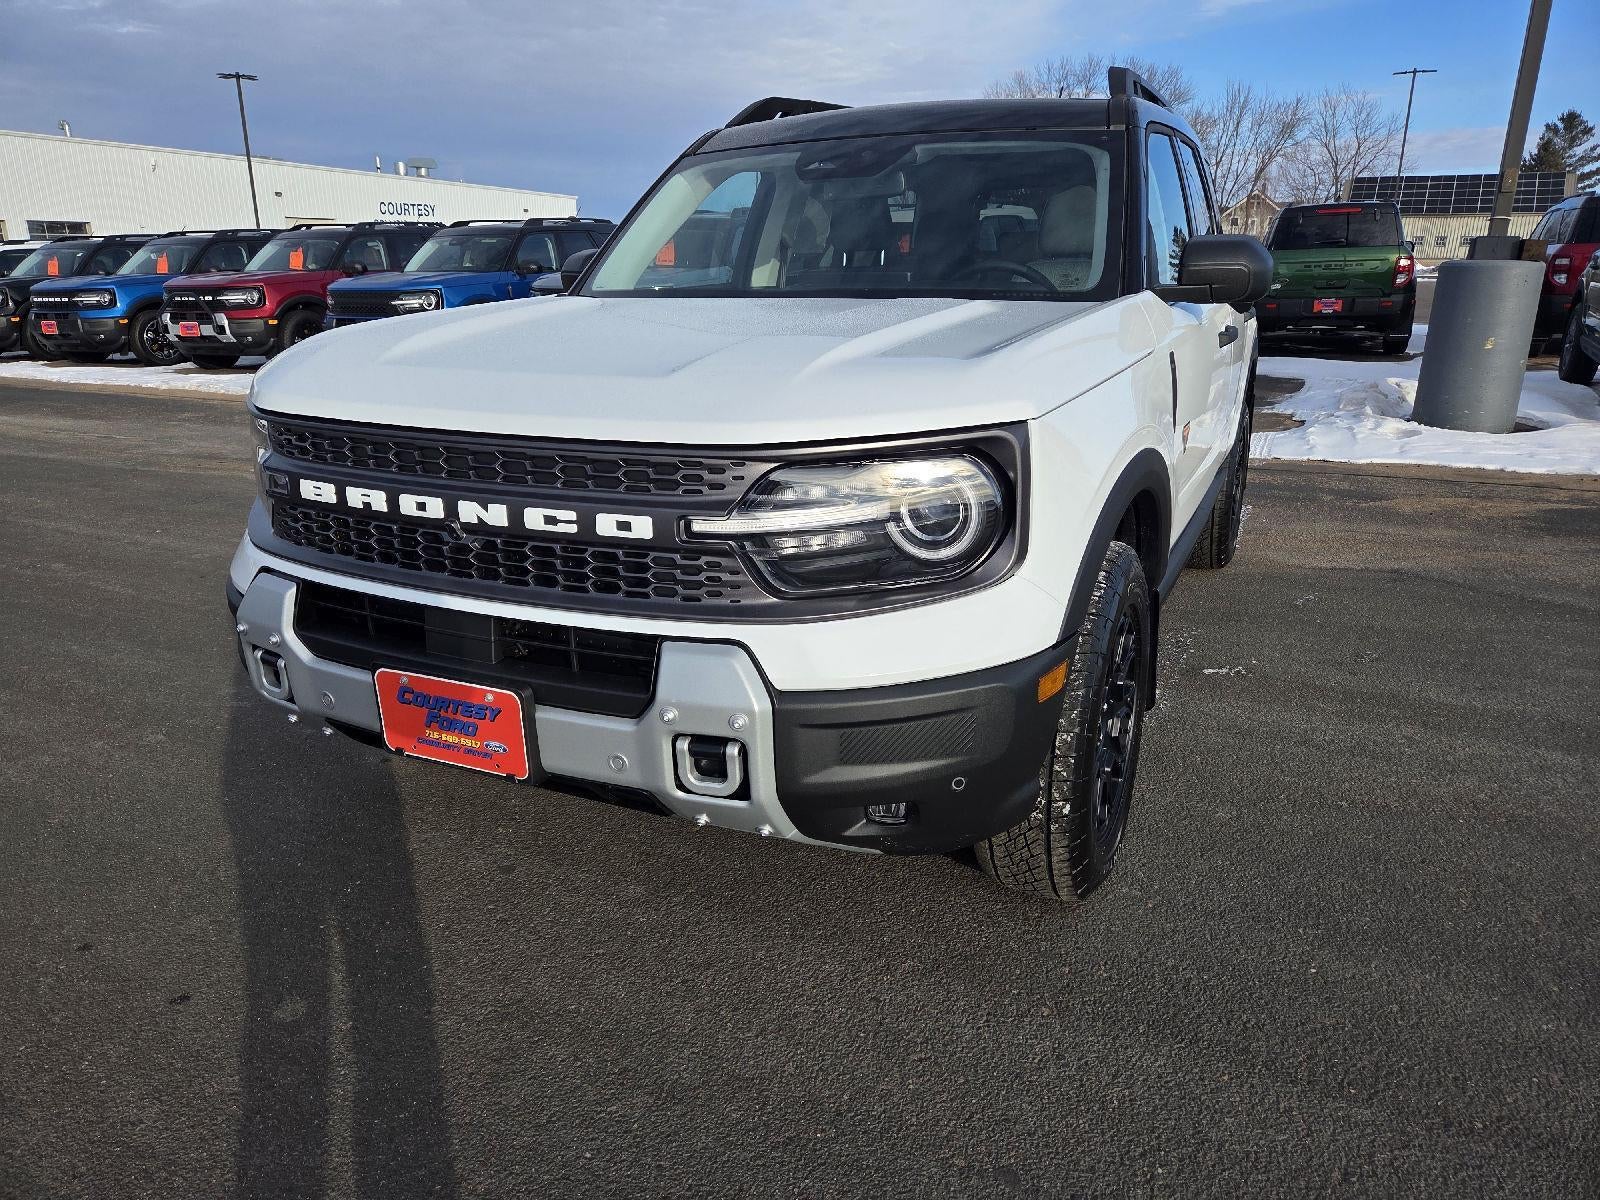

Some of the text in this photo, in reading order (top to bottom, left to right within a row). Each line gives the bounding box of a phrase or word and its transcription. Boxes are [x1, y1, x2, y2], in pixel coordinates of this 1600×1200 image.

[379, 201, 436, 217] COURTESY
[299, 478, 654, 540] BRONCO
[396, 685, 503, 723] COURTESY
[424, 709, 479, 738] FORD
